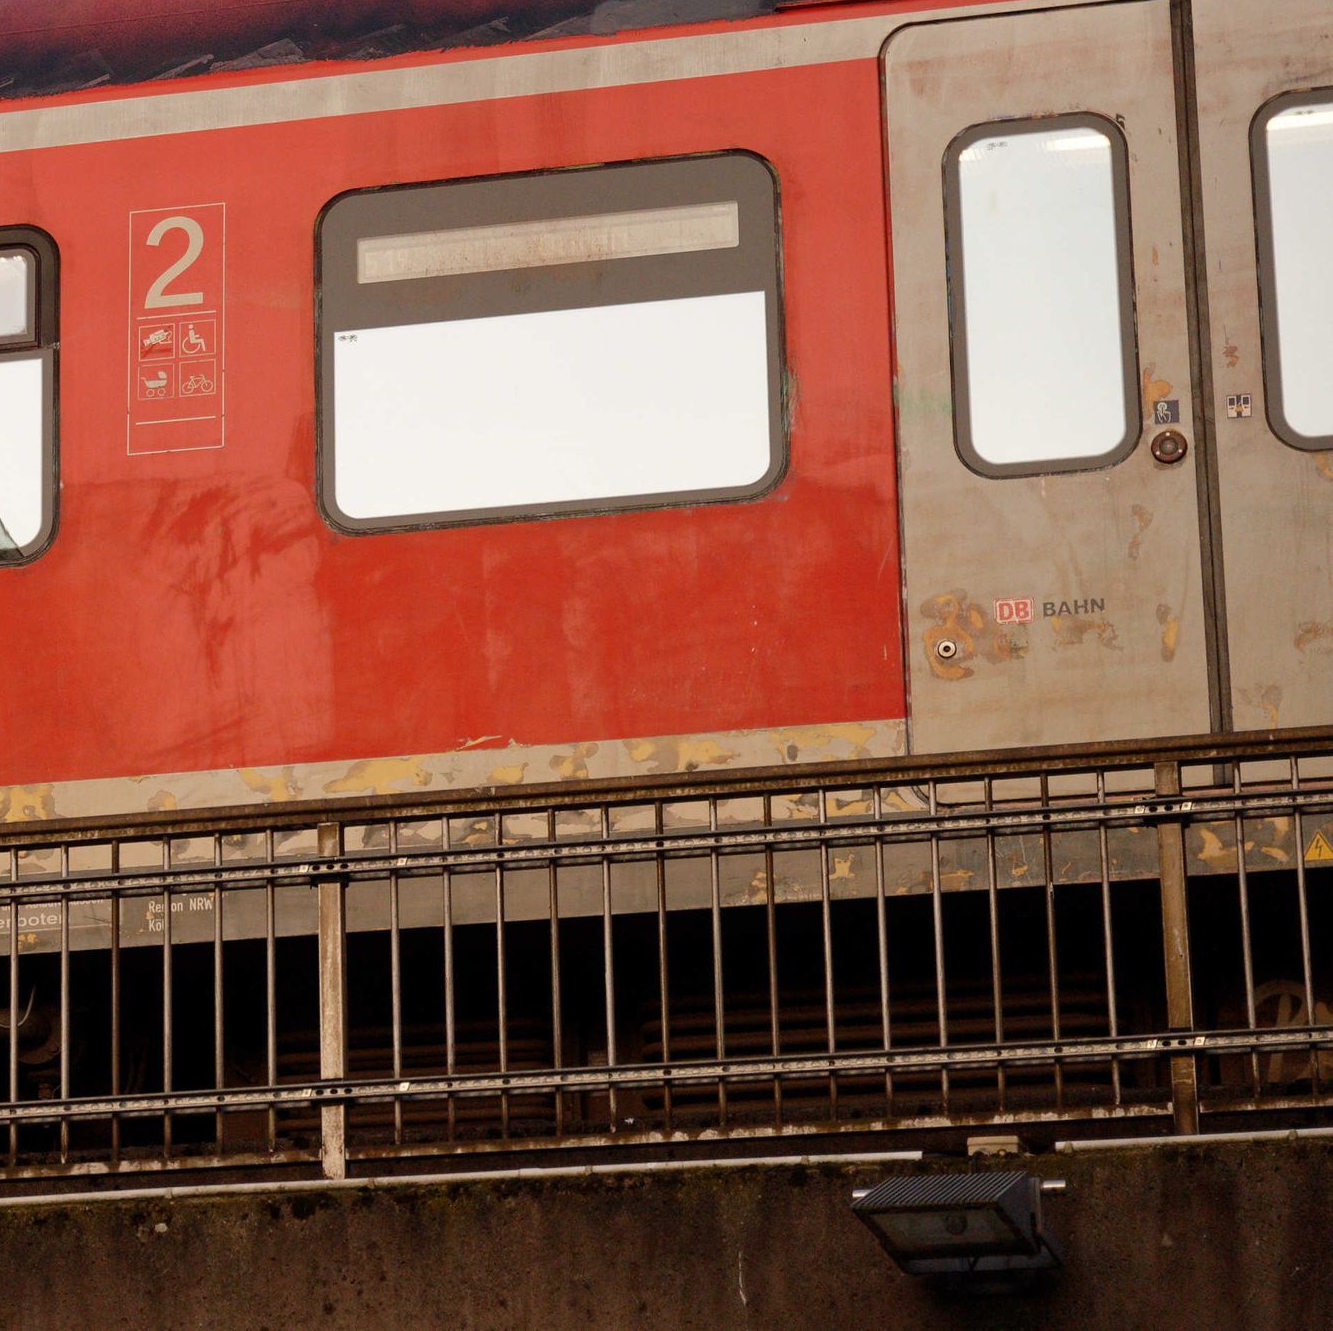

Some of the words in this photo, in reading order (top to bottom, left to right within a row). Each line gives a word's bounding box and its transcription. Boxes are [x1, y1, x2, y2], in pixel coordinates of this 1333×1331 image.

[144, 215, 204, 309] 2
[998, 602, 1030, 620] DB
[1042, 597, 1106, 617] BAHN
[148, 918, 165, 932] Köl
